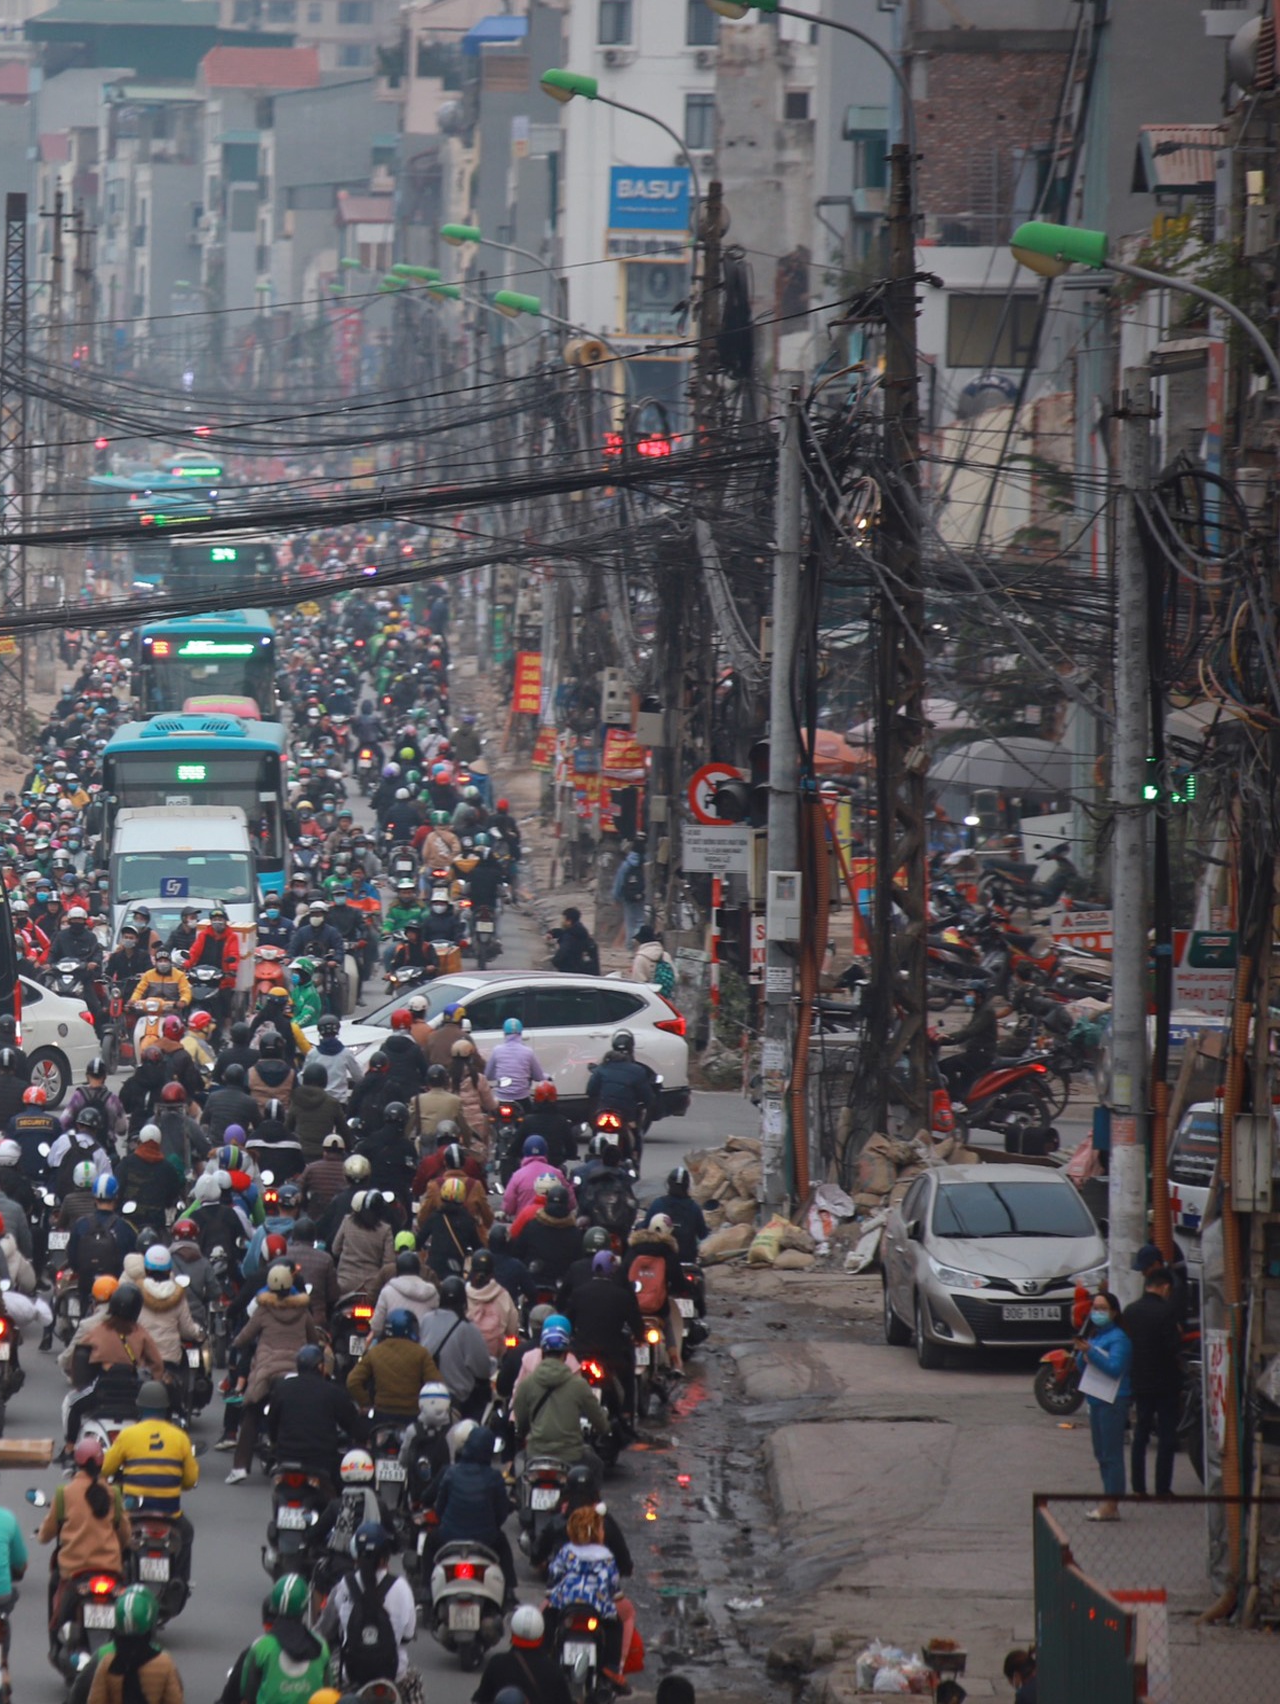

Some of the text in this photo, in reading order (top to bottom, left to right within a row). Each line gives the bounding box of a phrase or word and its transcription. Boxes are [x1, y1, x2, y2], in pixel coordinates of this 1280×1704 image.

[616, 180, 684, 199] BASU
[1176, 987, 1203, 1000] THAY
[280, 1679, 311, 1694] Grab
